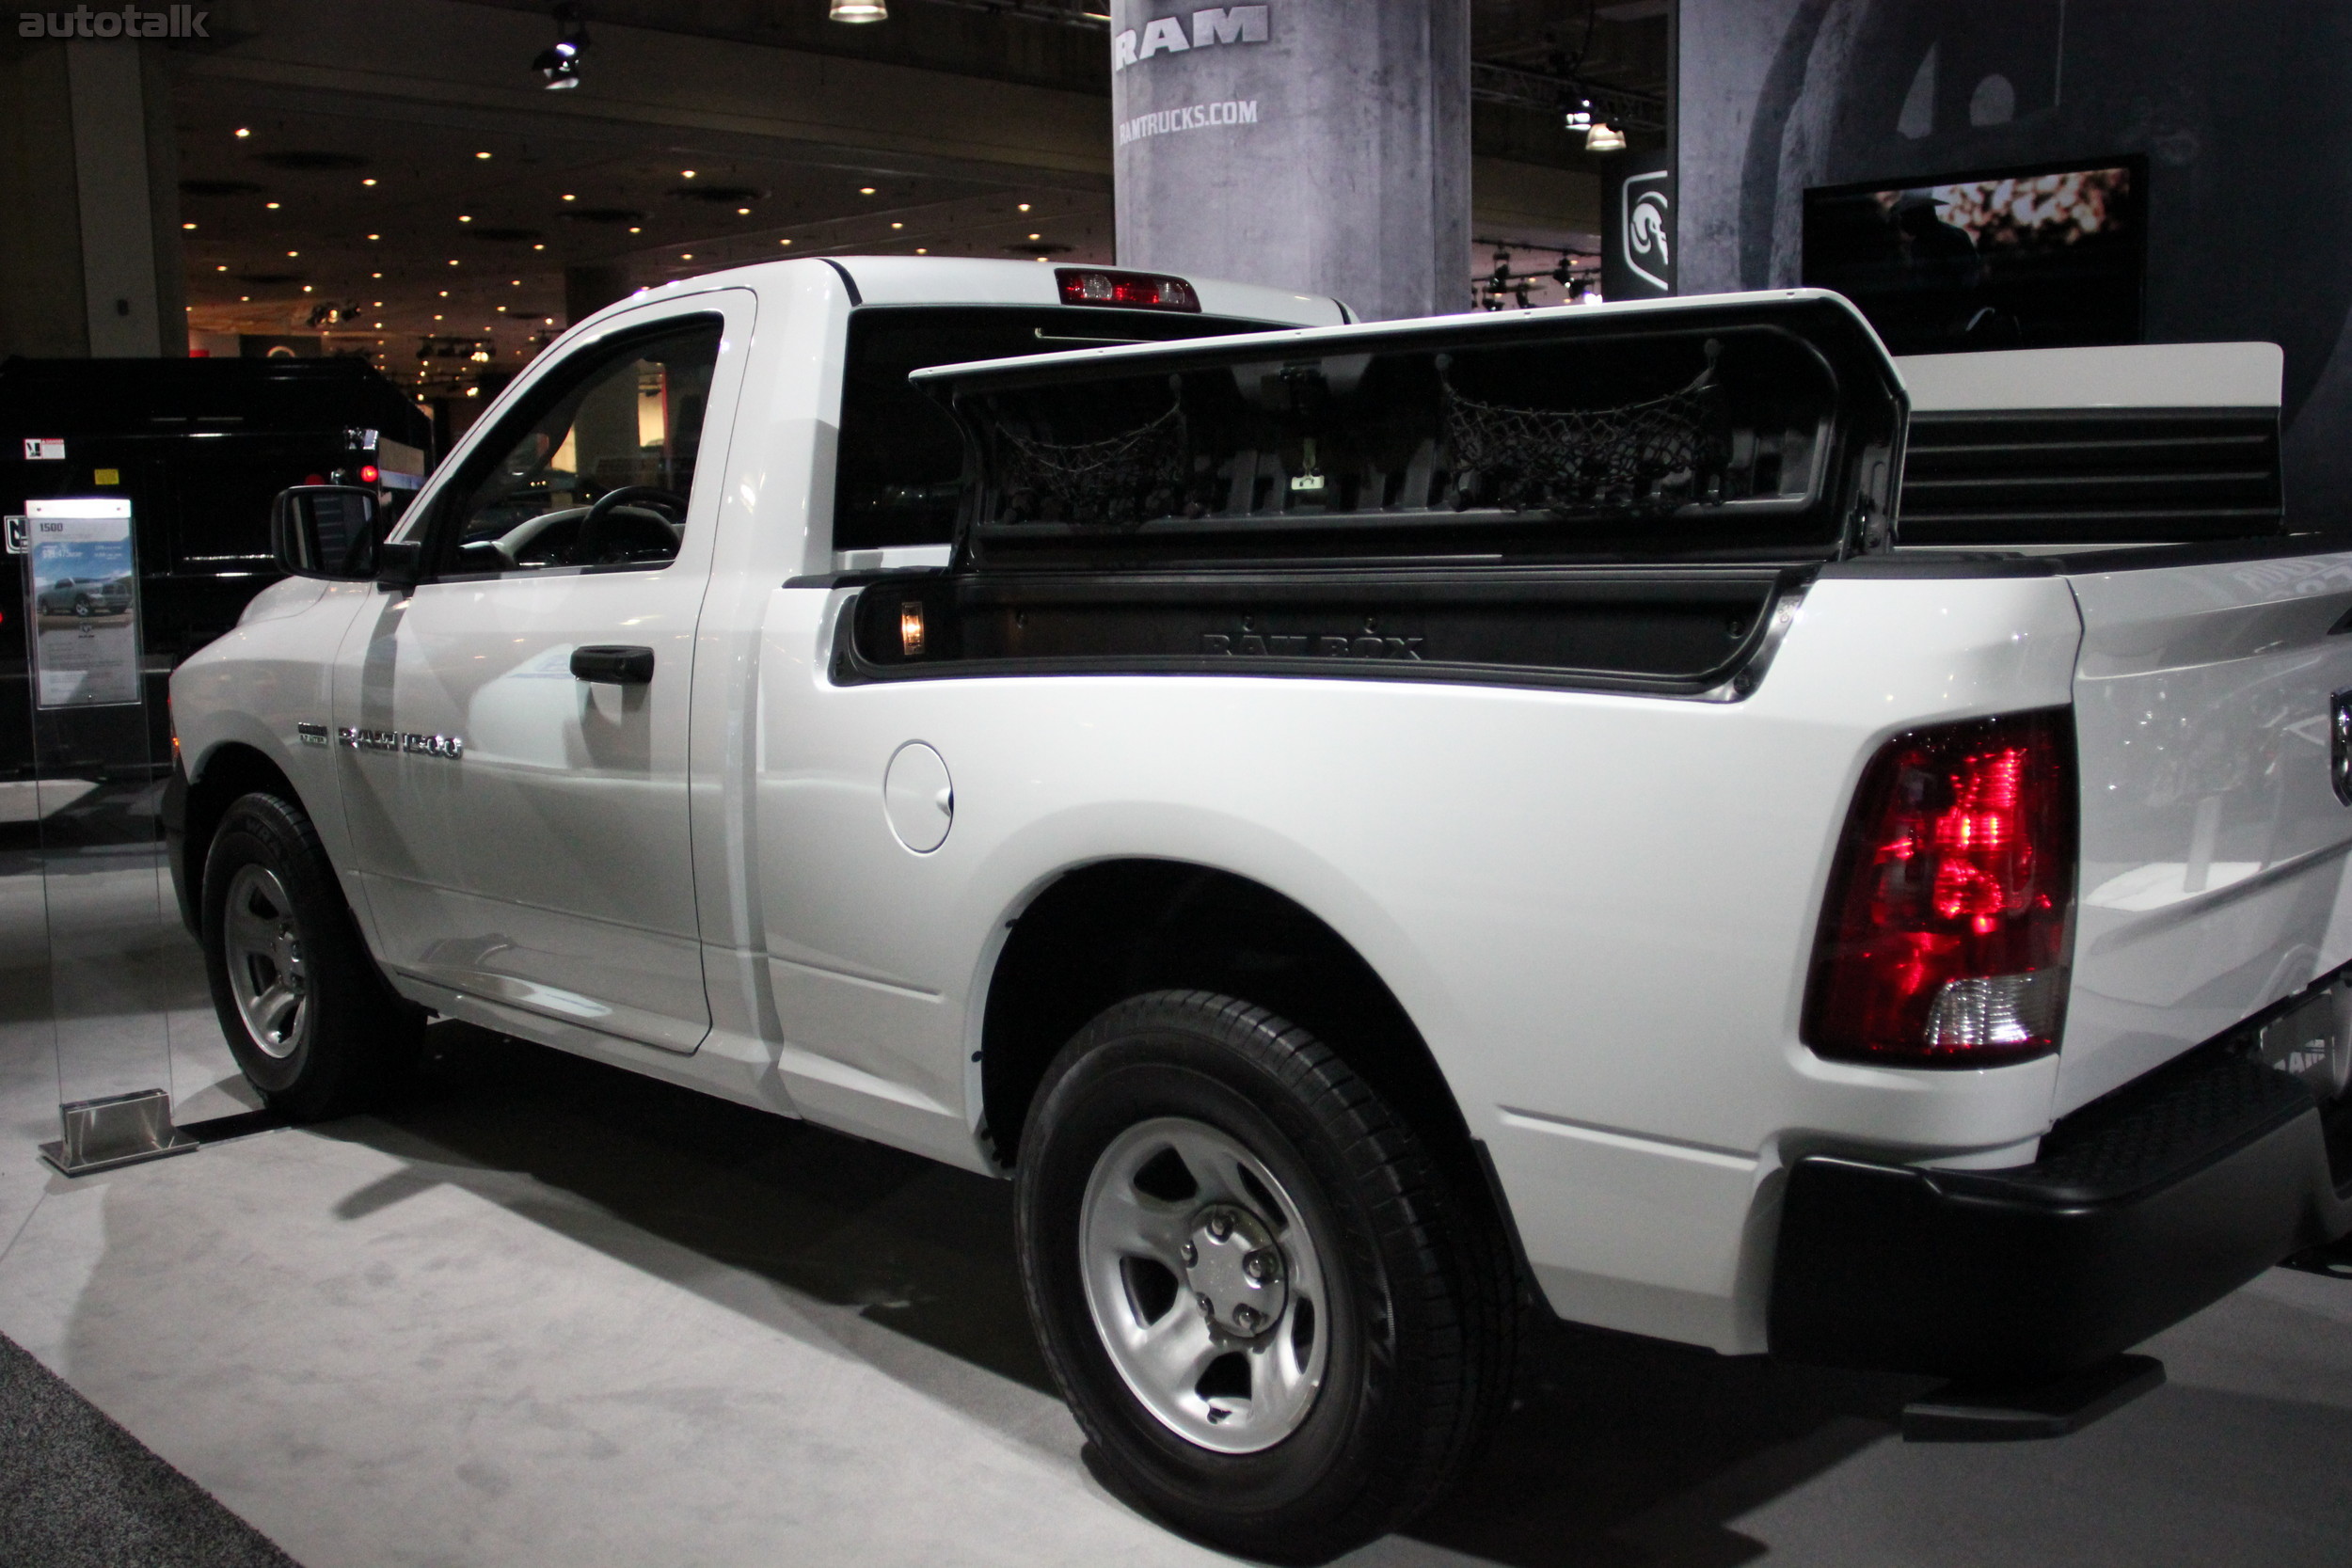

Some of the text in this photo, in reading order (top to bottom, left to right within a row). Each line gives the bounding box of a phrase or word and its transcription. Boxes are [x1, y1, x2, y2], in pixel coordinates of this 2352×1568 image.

[1115, 5, 1268, 71] RAM
[1120, 101, 1258, 146] RAMTRUCKS.COM
[40, 523, 63, 532] 1500
